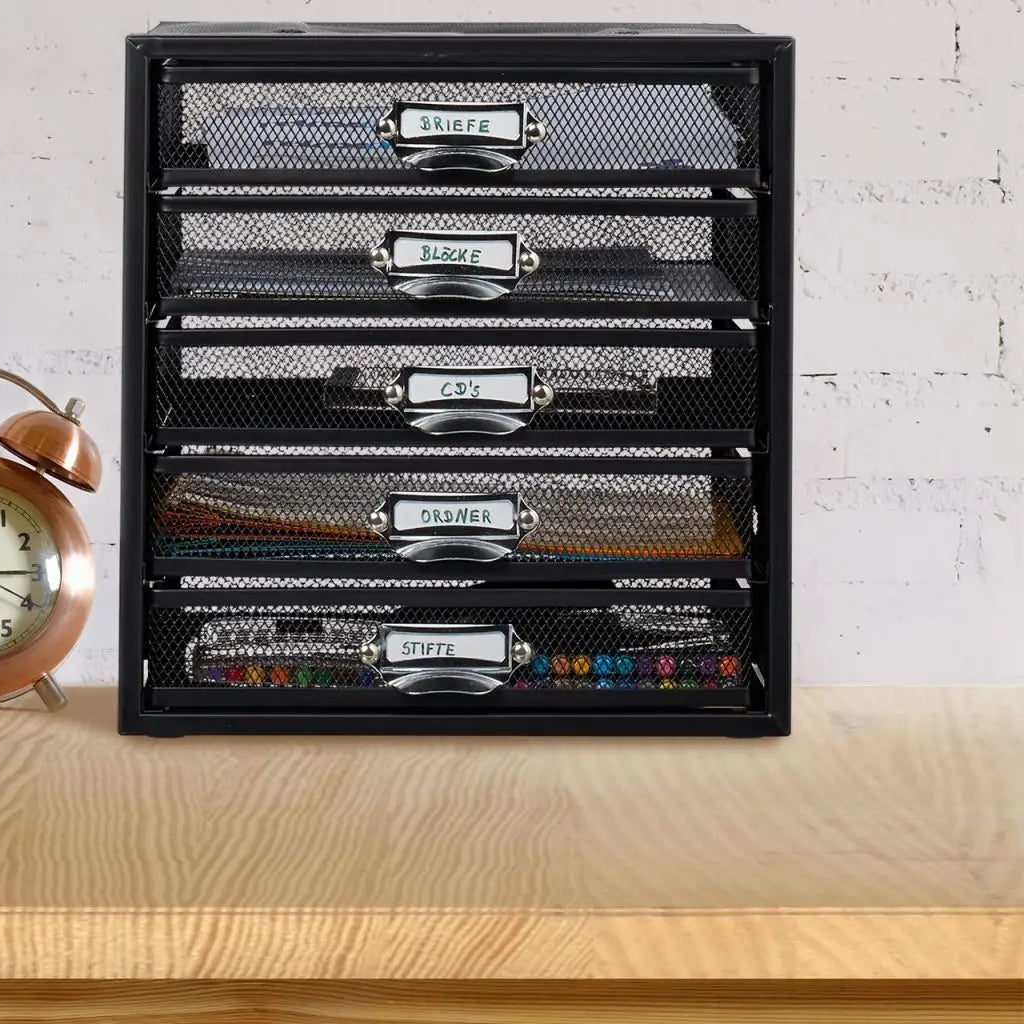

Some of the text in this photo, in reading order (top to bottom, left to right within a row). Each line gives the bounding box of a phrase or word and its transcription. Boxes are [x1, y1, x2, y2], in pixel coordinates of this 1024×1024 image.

[420, 115, 491, 133] BRIEFE
[0, 509, 6, 527] 1
[421, 507, 492, 524] ORDNER
[18, 532, 32, 551] 2
[31, 563, 43, 582] 3
[20, 592, 34, 612] 4
[1, 619, 13, 638] 5
[401, 641, 456, 656] STIFTE
